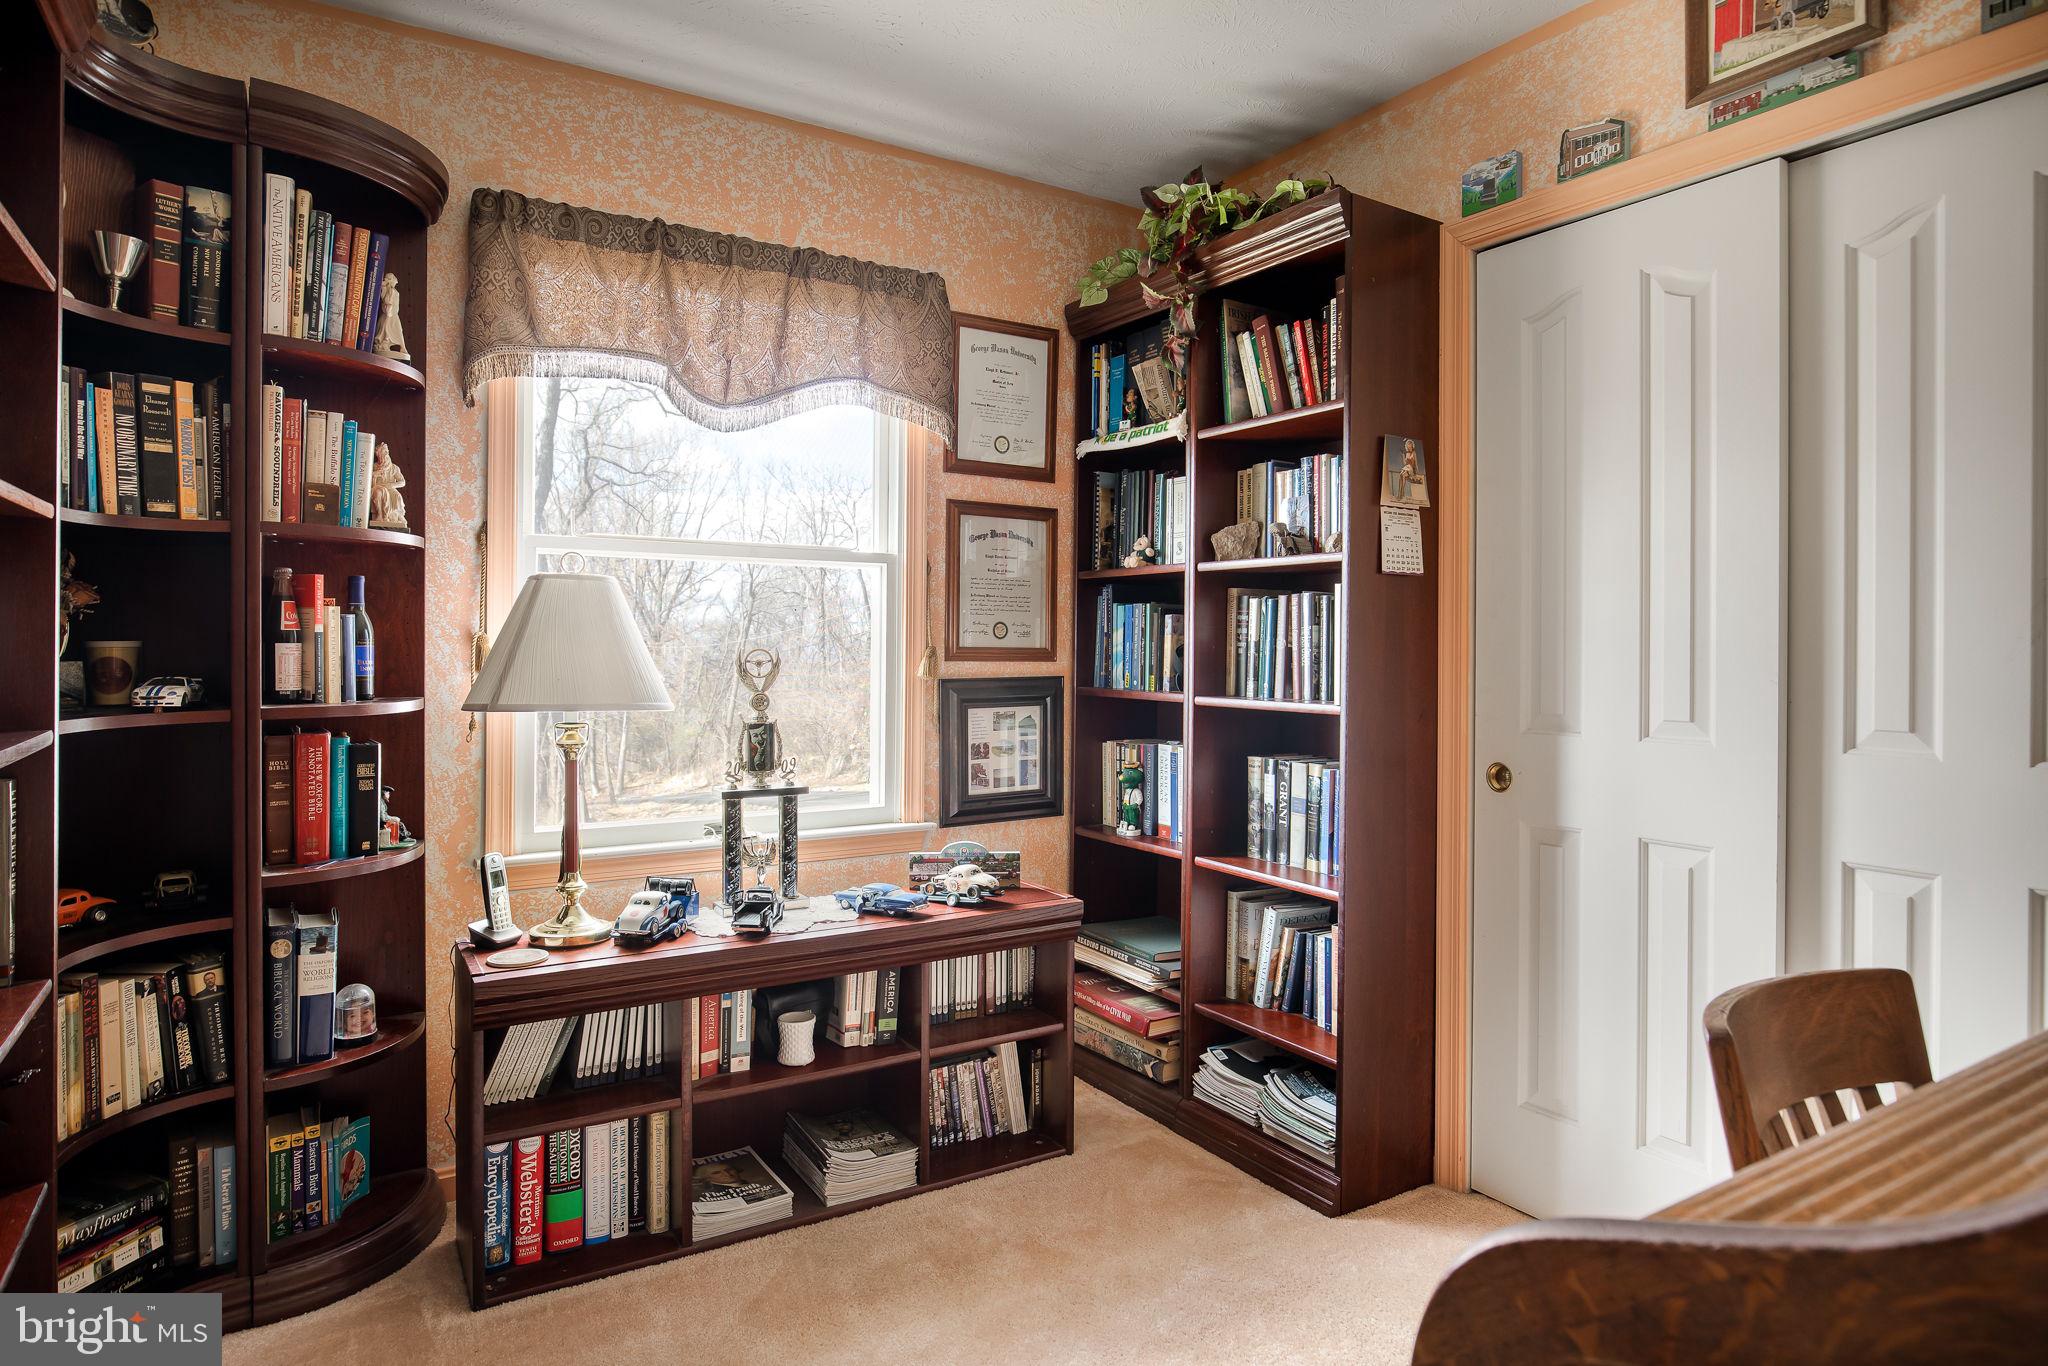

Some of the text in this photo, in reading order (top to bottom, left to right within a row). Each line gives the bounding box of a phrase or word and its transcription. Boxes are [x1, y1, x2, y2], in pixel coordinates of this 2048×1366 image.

[158, 204, 180, 214] WORKS
[271, 199, 284, 238] NATIVE
[357, 232, 368, 260] SOLDIERS
[271, 239, 283, 304] AMERICANS
[293, 243, 304, 318] INDIAN LEADERS
[352, 299, 360, 317] CAMP
[970, 343, 1037, 366] George Mason University
[1322, 359, 1329, 371] TO
[1262, 348, 1273, 379] SALISBURY
[1269, 379, 1277, 401] PRISON
[77, 400, 85, 420] Women
[143, 404, 172, 416] Roosevelt
[145, 394, 169, 406] Eleanor
[77, 425, 85, 434] the
[77, 434, 85, 447] Civil
[211, 417, 221, 464] AMERICAN
[1119, 421, 1169, 442] a patriot
[77, 448, 85, 460] War
[115, 413, 138, 497] NO ORDINARY TIME
[180, 418, 195, 490] WARRIOR PRIEST
[330, 449, 338, 475] Buffalo
[212, 466, 221, 499] JEZEBEL
[272, 445, 281, 507] SCOUNDRELS
[308, 747, 316, 821] ANNOTATED BIBLE
[315, 746, 323, 814] THE NEW OXFORD
[356, 767, 375, 776] BIBLE
[1279, 781, 1288, 828] GRANT
[1076, 935, 1129, 962] READING NEWSWEEK
[1259, 914, 1274, 995] DEFEND VALLEY
[303, 967, 334, 977] WORLD
[303, 974, 334, 982] RELIGIONS
[273, 963, 283, 1039] BIBLICAL WORLD
[886, 970, 896, 1014] AMERICA
[84, 989, 92, 1037] SALEM
[123, 983, 138, 1048] ORDEAL HUNGER
[215, 1002, 224, 1043] THEODORE
[708, 999, 718, 1040] America
[1110, 1006, 1131, 1022] CIVIL WAR
[175, 1029, 187, 1070] ROOSEVELT
[181, 1026, 193, 1066] THEODORE
[988, 1093, 997, 1115] SLAVERY
[656, 1123, 666, 1144] Lifetime
[293, 1150, 304, 1192] Mammals
[308, 1141, 319, 1196] Eastern Birds
[569, 1127, 581, 1180] OXFORD
[619, 1125, 627, 1217] DICTIONARY OF PROBLEM
[632, 1146, 640, 1173] Dictionary
[655, 1144, 666, 1179] Encyclopedia
[221, 1167, 232, 1231] The Great Plains
[484, 1156, 500, 1243] Encyclopedia
[519, 1153, 538, 1235] Webster's
[533, 1185, 542, 1220] Merriam-
[657, 1186, 666, 1205] Letters
[58, 1205, 136, 1249] Mayflower
[515, 1233, 540, 1241] Collegiate
[515, 1237, 541, 1246] Dictionary
[553, 1236, 579, 1247] OXFORD
[62, 1270, 86, 1289] 1491
